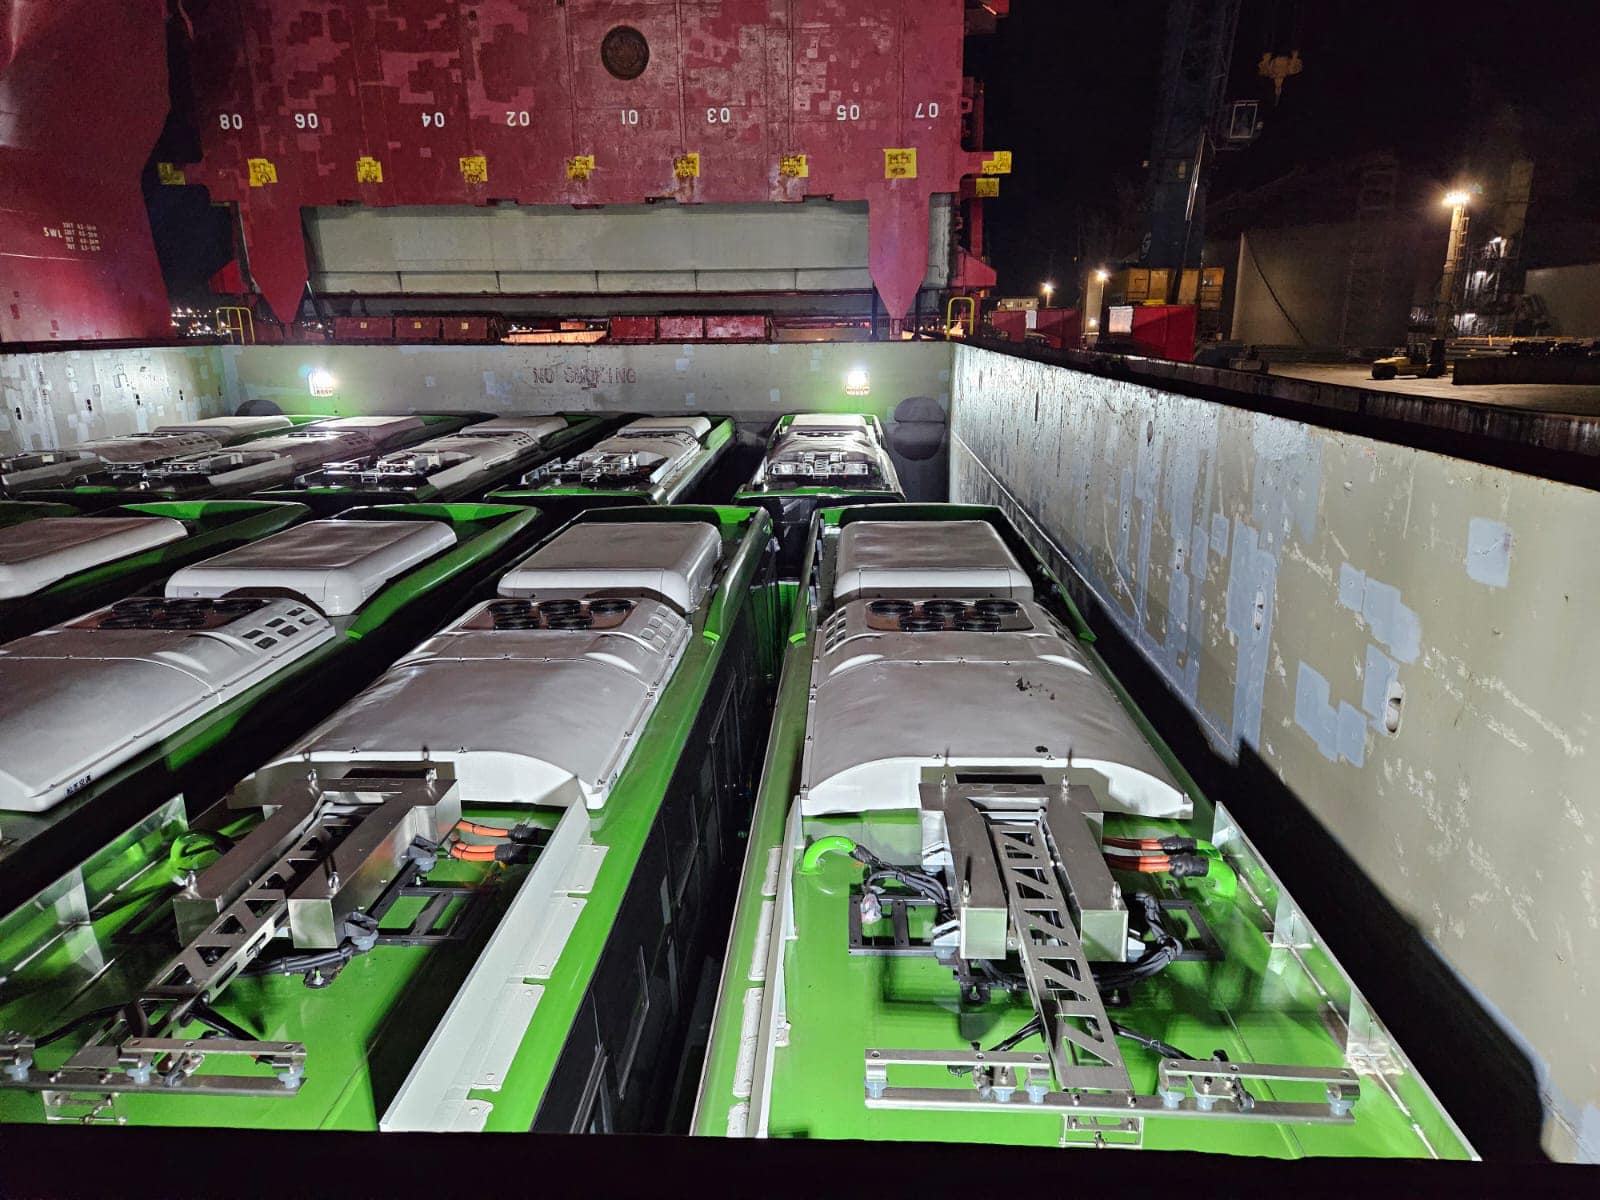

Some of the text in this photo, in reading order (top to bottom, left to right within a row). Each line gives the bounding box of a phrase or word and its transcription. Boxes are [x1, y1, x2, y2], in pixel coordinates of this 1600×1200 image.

[506, 111, 530, 127] 02
[621, 109, 639, 125] 01
[706, 107, 731, 124] 03
[836, 104, 860, 121] 05
[915, 102, 939, 119] 07
[219, 113, 243, 130] 08
[294, 112, 319, 129] 06
[421, 112, 446, 128] 04
[43, 227, 63, 239] SWL
[533, 367, 555, 384] NO
